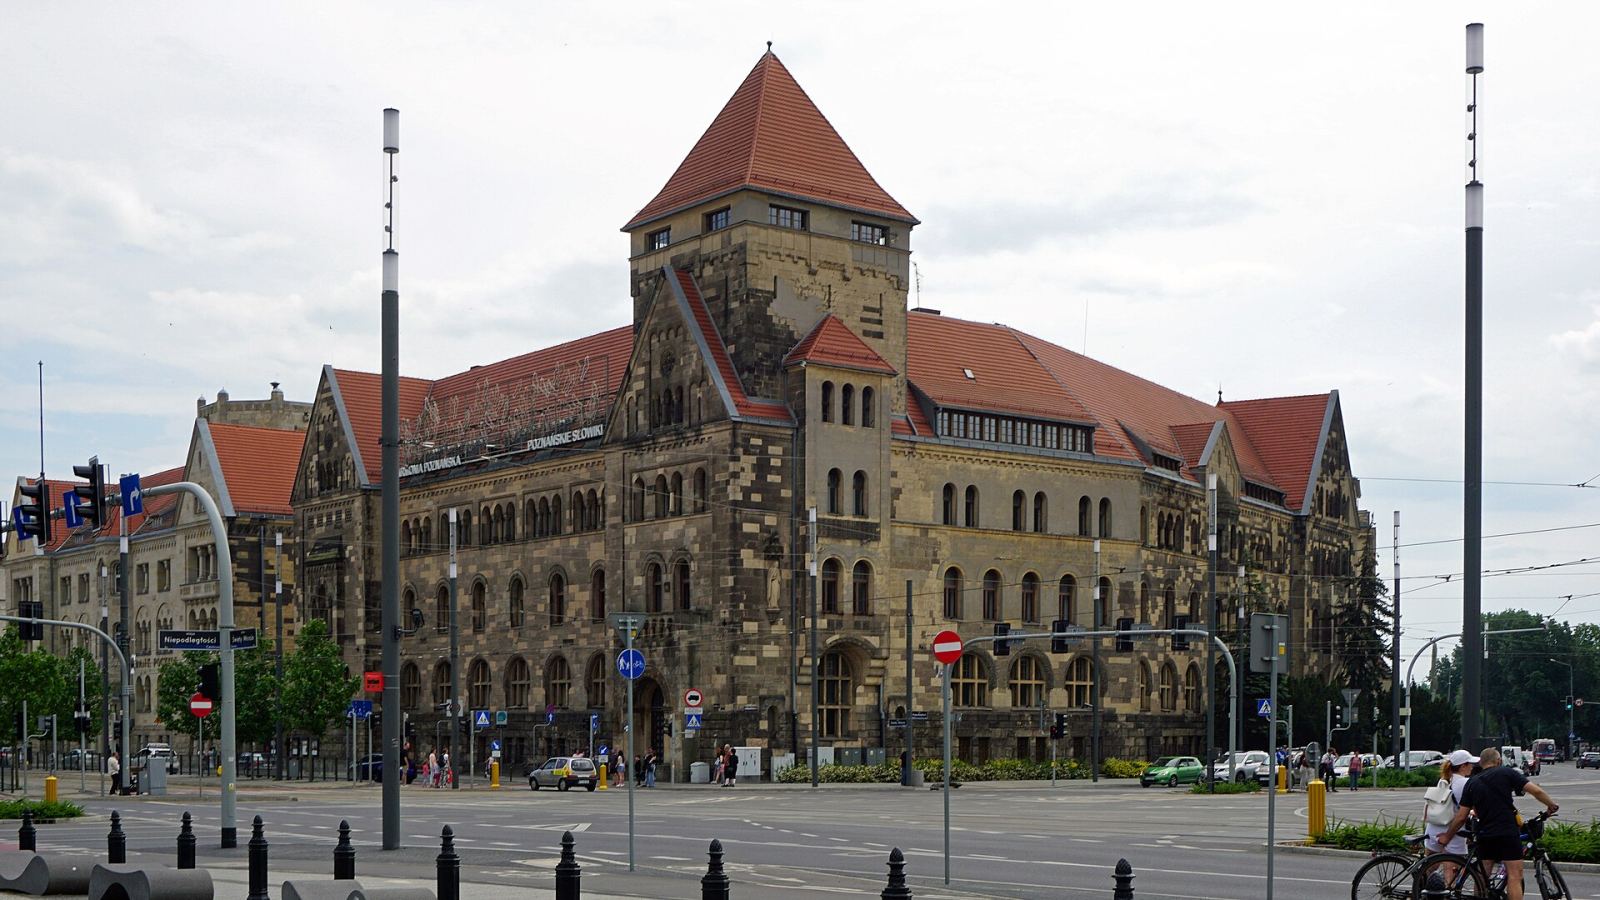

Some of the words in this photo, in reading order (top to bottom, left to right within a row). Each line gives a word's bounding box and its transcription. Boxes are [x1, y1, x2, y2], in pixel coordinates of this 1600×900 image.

[527, 431, 572, 450] POZNAŃSKIE
[572, 424, 603, 441] SŁOWIKI
[424, 455, 462, 473] POZNAŃSKA
[164, 636, 217, 645] Niepodległości
